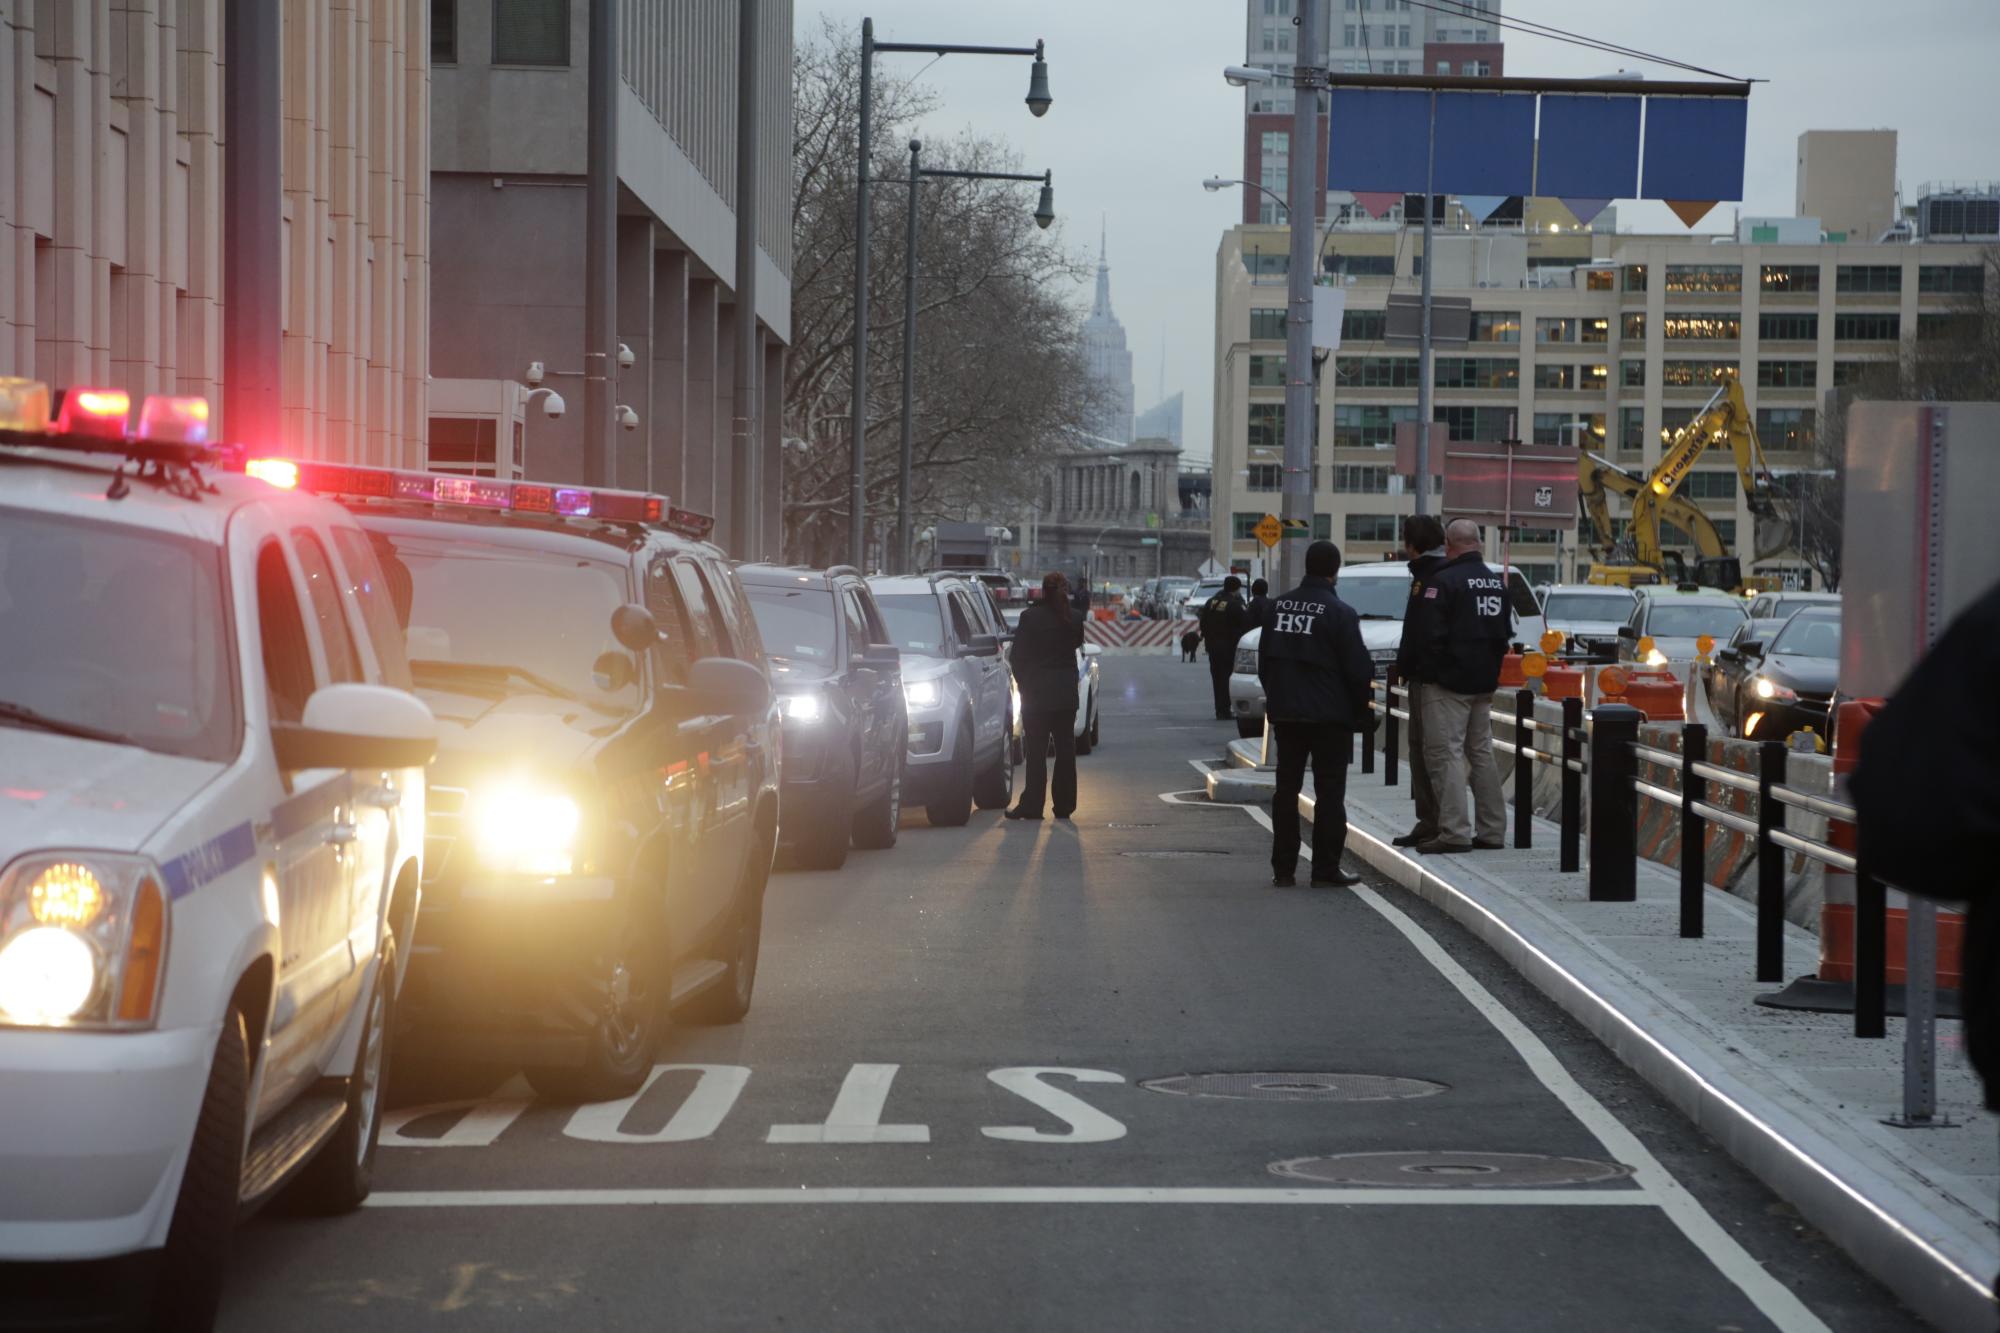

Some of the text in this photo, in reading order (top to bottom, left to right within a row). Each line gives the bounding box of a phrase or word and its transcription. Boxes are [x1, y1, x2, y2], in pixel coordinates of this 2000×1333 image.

[1670, 430, 1709, 478] KOMATSU
[1467, 577, 1503, 590] POLICE
[1276, 599, 1326, 615] POLICE
[1273, 612, 1316, 635] HSI
